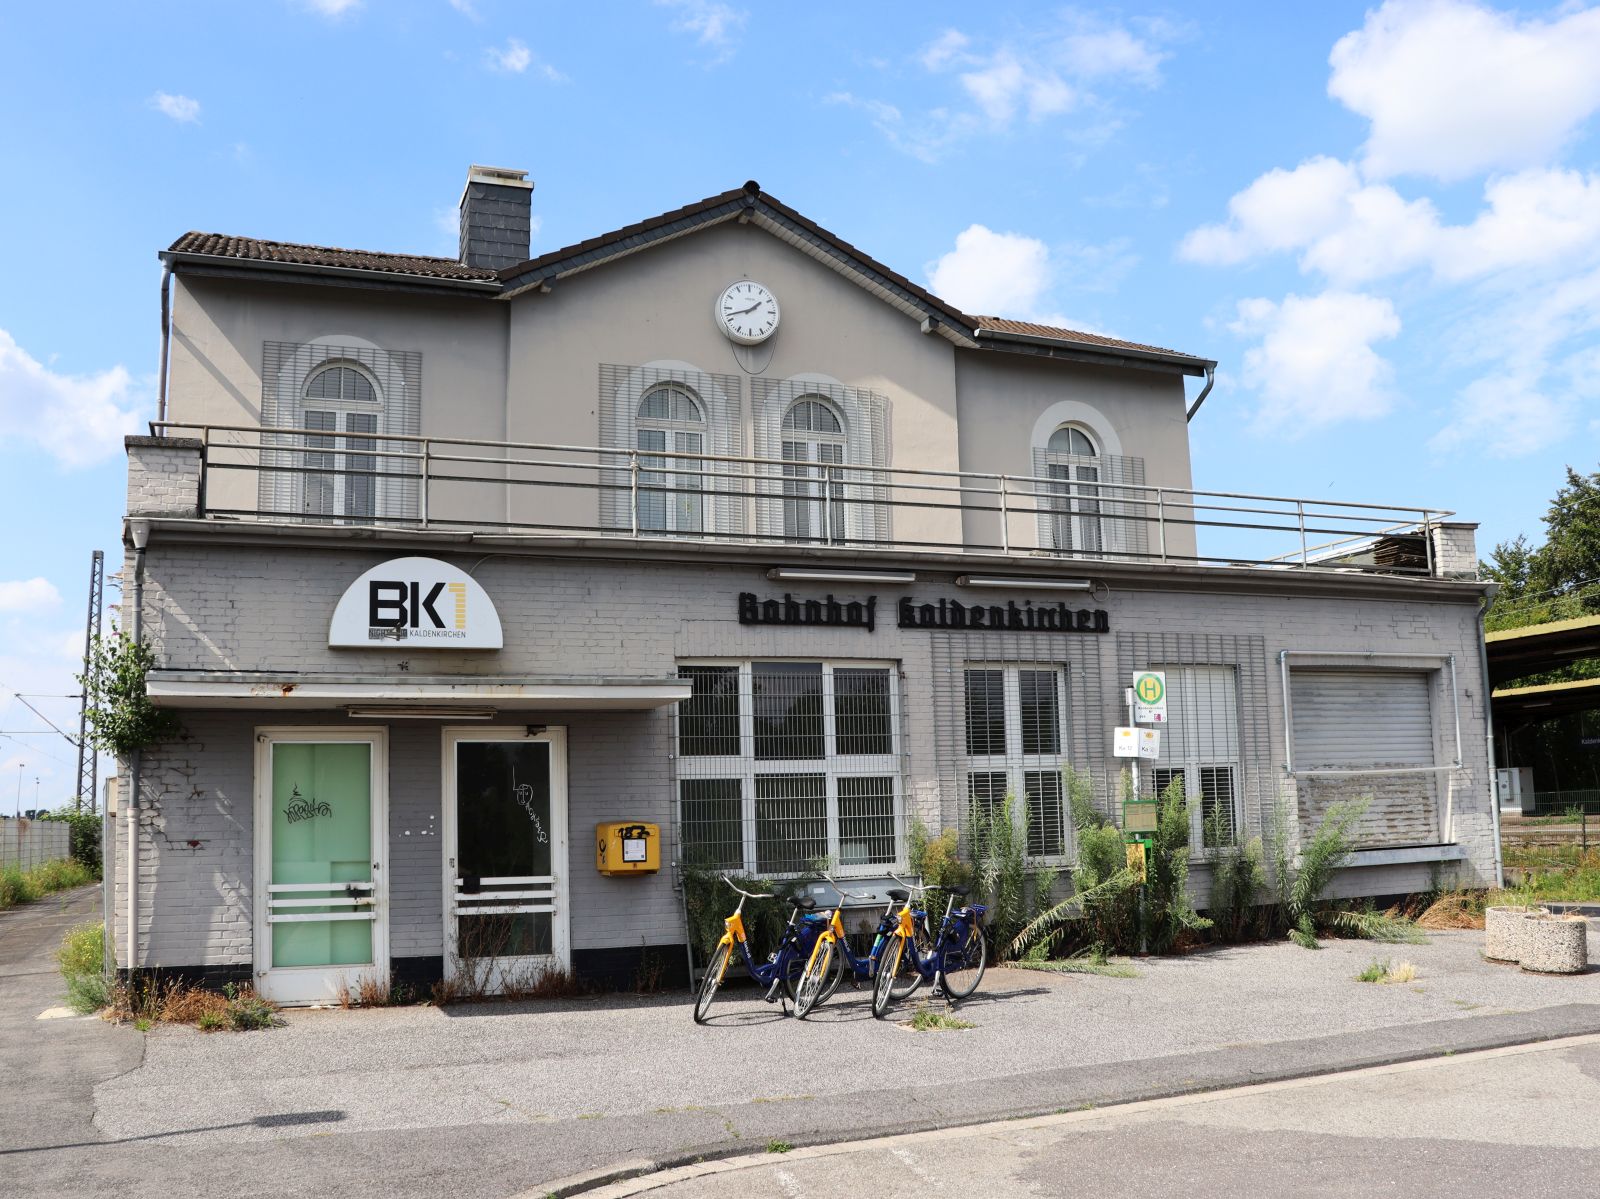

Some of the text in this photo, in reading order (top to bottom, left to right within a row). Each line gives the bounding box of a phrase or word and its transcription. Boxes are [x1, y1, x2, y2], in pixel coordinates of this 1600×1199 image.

[369, 580, 467, 629] BK1
[739, 592, 1110, 633] Bahnhof Kaldenkirchen
[409, 629, 466, 638] KALDENKIRCHEN
